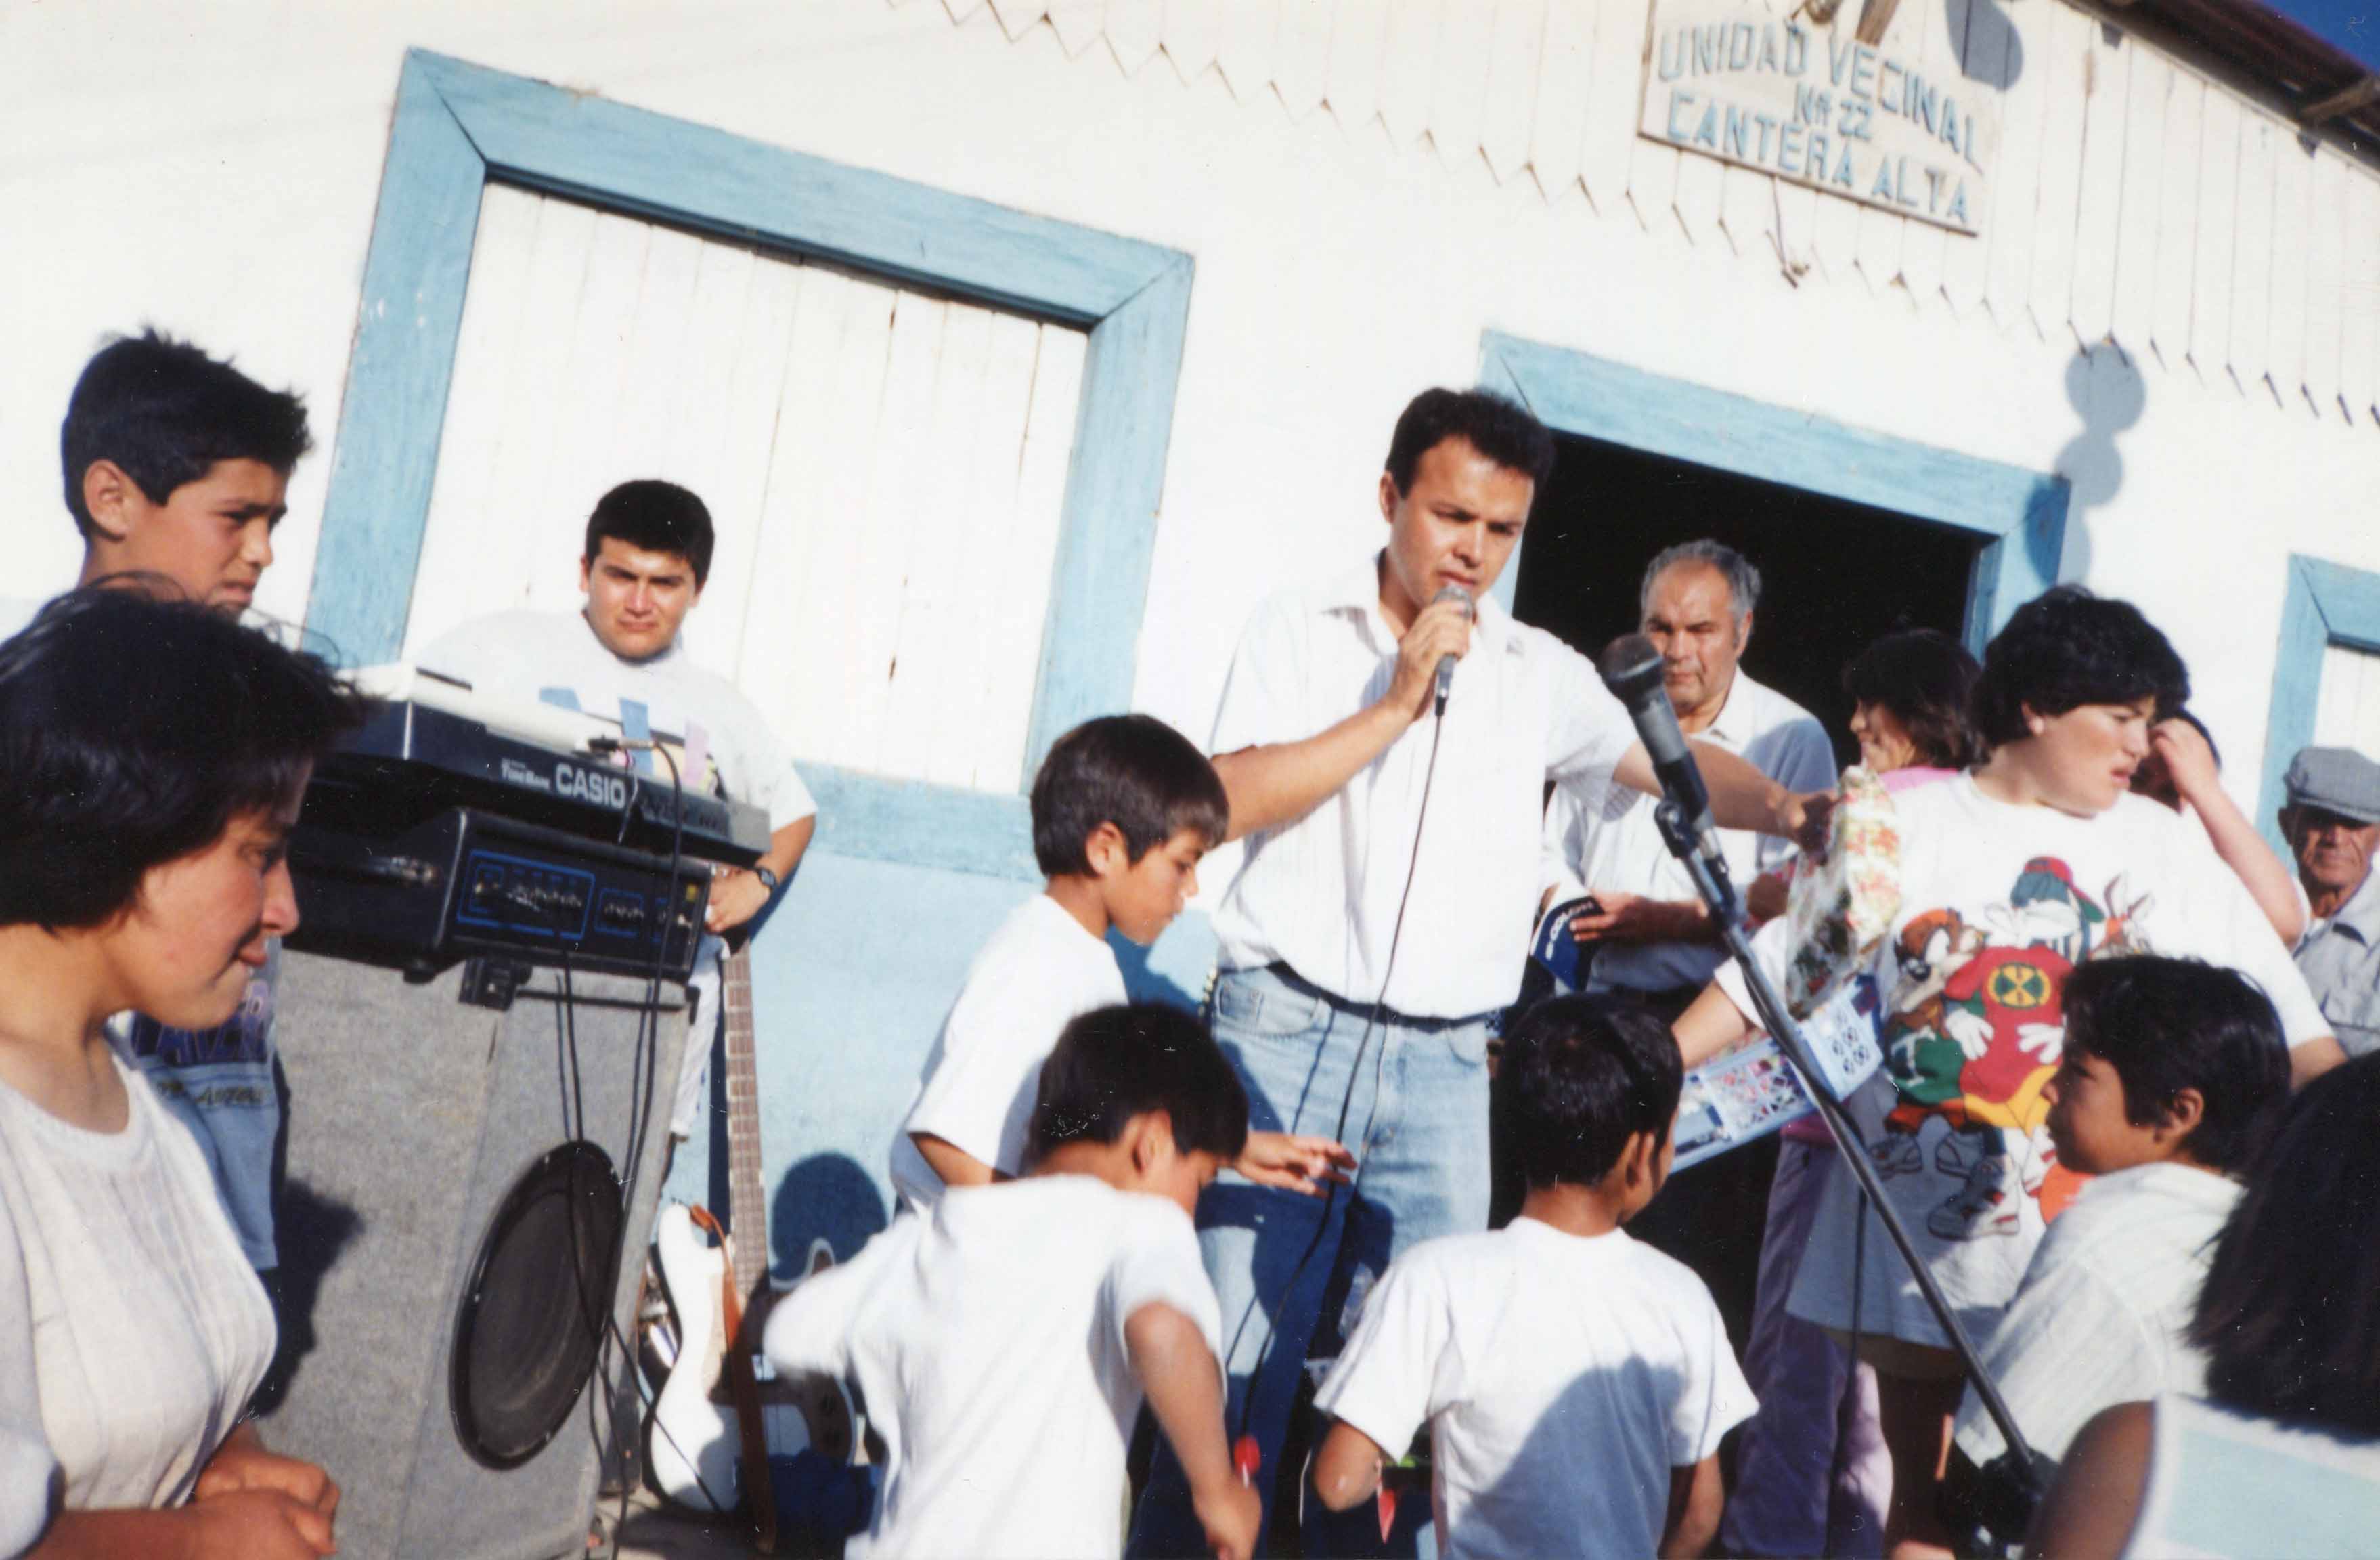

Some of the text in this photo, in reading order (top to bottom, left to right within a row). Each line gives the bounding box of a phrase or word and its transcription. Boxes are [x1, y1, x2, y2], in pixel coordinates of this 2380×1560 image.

[1658, 20, 1977, 167] UNIDAD VECINAL
[1837, 98, 1874, 141] 22
[1667, 85, 1968, 224] CANTERA ALTA
[555, 762, 626, 810] CASIO
